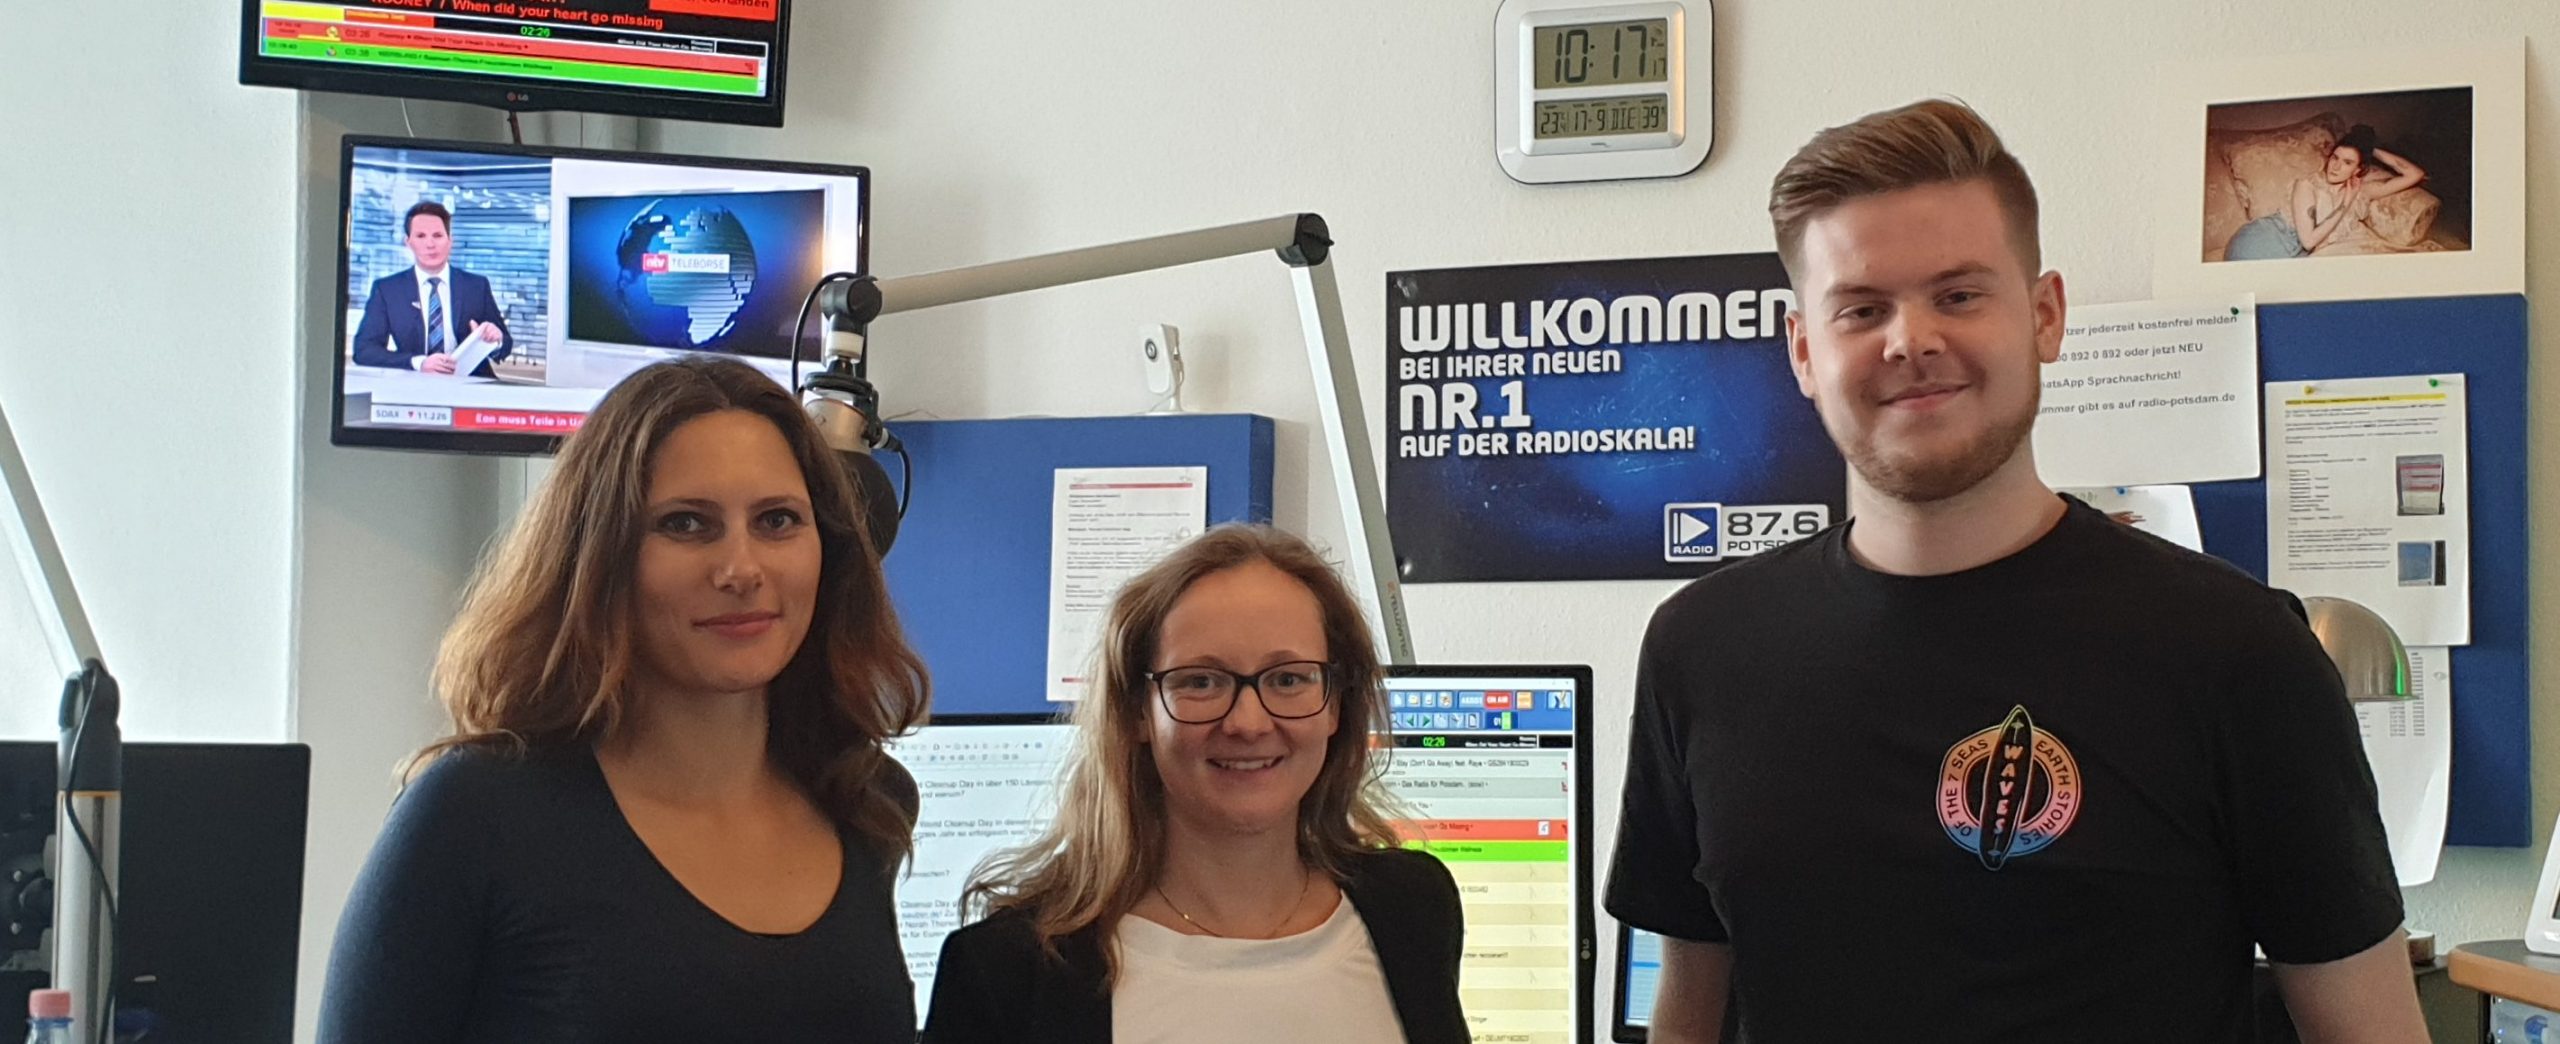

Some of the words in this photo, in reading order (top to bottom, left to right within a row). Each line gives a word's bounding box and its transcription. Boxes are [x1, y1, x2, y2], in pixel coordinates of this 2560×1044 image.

[453, 0, 491, 13] When
[494, 3, 515, 14] did
[519, 7, 550, 18] your
[553, 8, 588, 21] heart
[591, 14, 609, 25] go
[612, 15, 664, 30] missing
[1555, 26, 1647, 84] 10:17
[1400, 289, 1797, 353] WILLKOMMEN
[2088, 322, 2135, 338] jederzeit
[2137, 318, 2193, 331] kostenfrei
[2196, 315, 2238, 328] melden
[1400, 357, 1440, 380] BEI
[1447, 354, 1525, 378] IHRER
[1533, 350, 1621, 375] NEUEN
[2070, 352, 2090, 362] 892
[2092, 351, 2099, 360] 0
[2102, 349, 2121, 359] 892
[2124, 347, 2149, 358] oder
[2151, 345, 2176, 359] jetzt
[2178, 342, 2204, 353] NEU
[2087, 370, 2181, 387] Sprachnachricht!
[1400, 380, 1531, 430] NR.1
[2078, 402, 2099, 415] gibt
[2102, 402, 2115, 410] es
[2118, 398, 2136, 410] auf
[2138, 392, 2236, 409] radio-potsdam.de
[498, 415, 527, 425] muss
[530, 415, 556, 426] Teile
[1400, 434, 1451, 458] AUF
[1458, 433, 1509, 456] DER
[1516, 426, 1695, 454] RADIOSKALA!
[1727, 511, 1820, 536] 87.6
[1673, 545, 1713, 554] RADIO
[1951, 739, 1988, 770] SEAS
[2035, 740, 2071, 786] EARTH
[1947, 774, 1960, 782] 7
[1993, 744, 2024, 835] WAVES
[1945, 788, 1960, 819] THE
[2019, 789, 2071, 846] STORIES
[1953, 821, 1972, 837] OF
